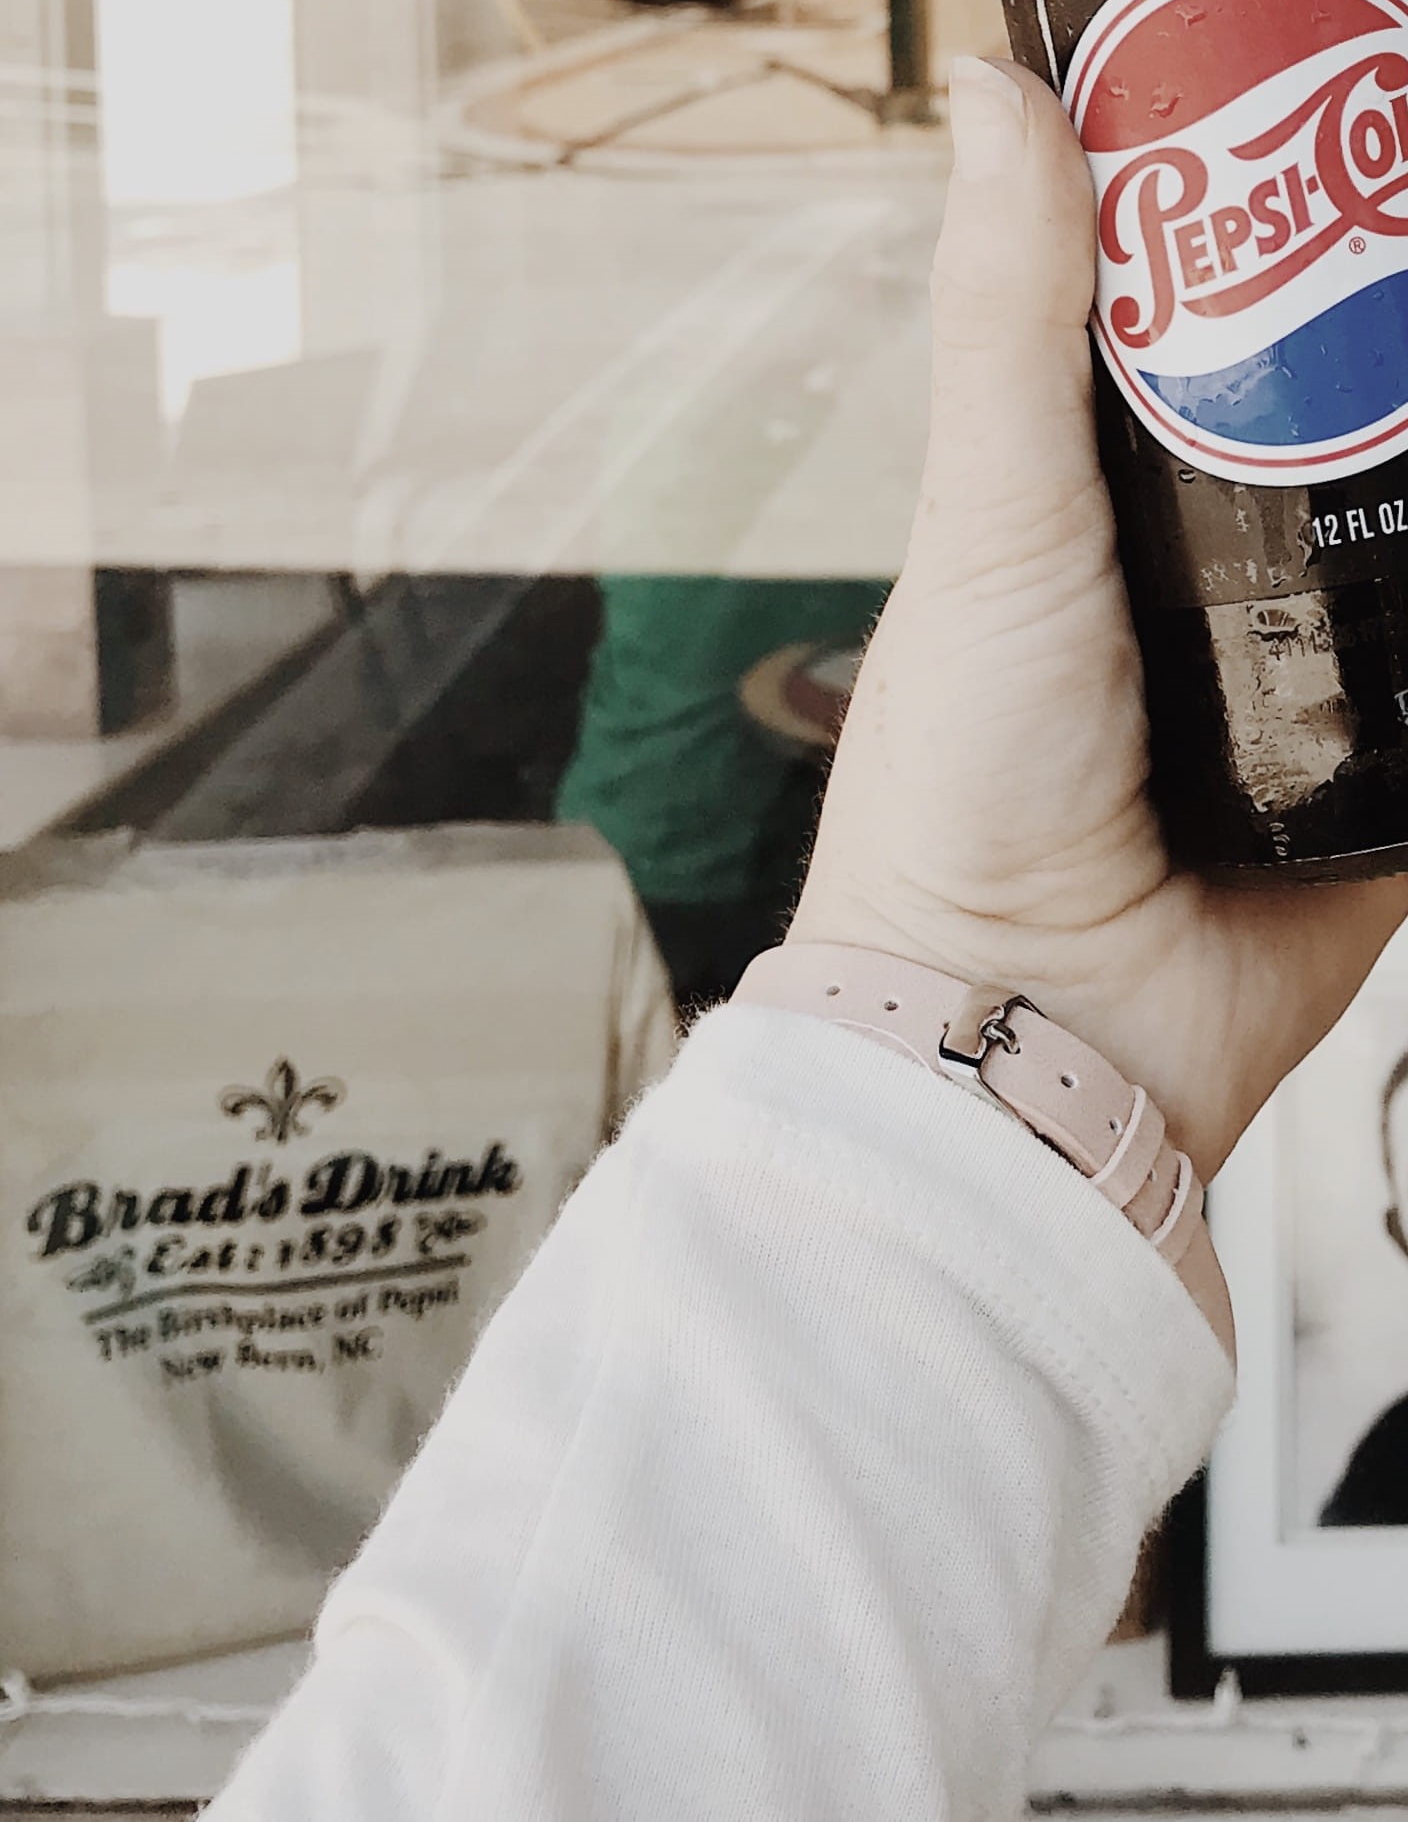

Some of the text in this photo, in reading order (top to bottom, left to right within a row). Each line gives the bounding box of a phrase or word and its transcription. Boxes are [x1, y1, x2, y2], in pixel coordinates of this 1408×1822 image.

[1312, 513, 1342, 549] 12
[1346, 506, 1375, 542] FL
[1378, 499, 1408, 535] OZ
[25, 1141, 522, 1258] Brad's Drink
